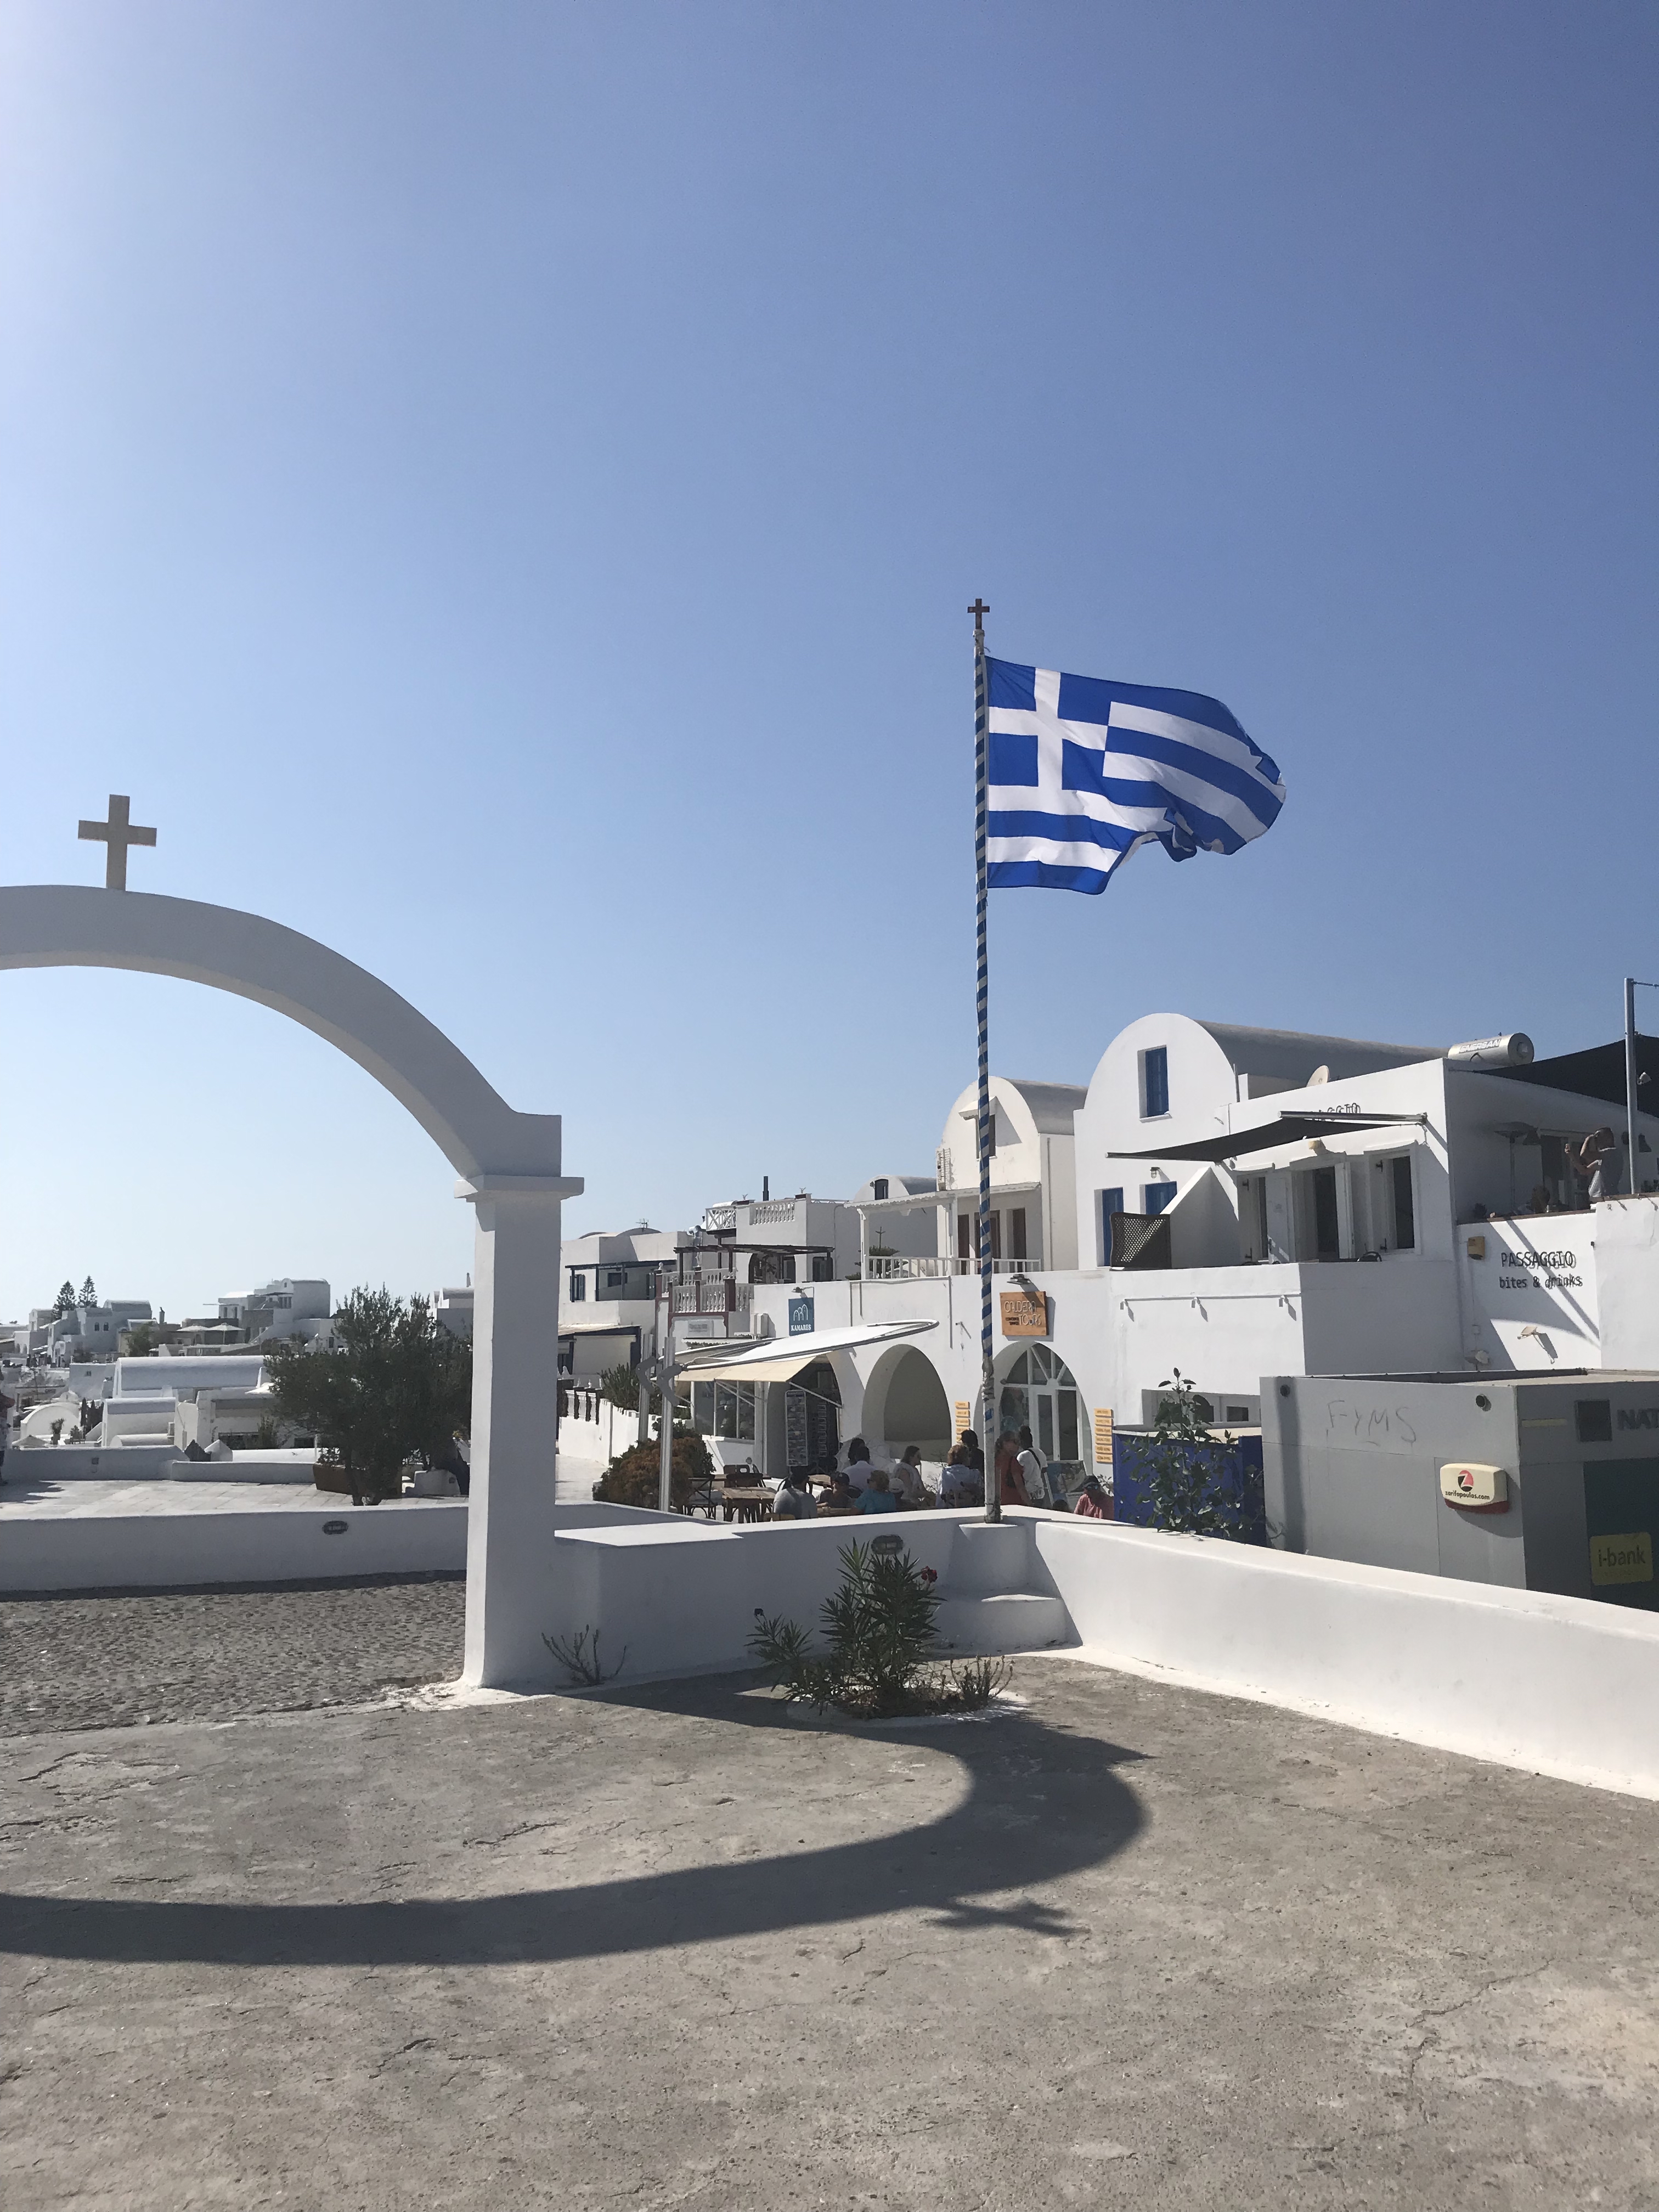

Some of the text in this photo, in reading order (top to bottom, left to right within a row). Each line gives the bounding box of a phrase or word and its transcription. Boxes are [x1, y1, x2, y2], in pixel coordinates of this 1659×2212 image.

[1459, 1039, 1502, 1053] ENERSAN
[1501, 1251, 1573, 1267] PASSAGGIO
[1499, 1274, 1582, 1288] bites & drinks
[1005, 1301, 1036, 1312] CALDERA
[1018, 1313, 1041, 1325] TOURS
[1598, 1545, 1646, 1567] i-bank
